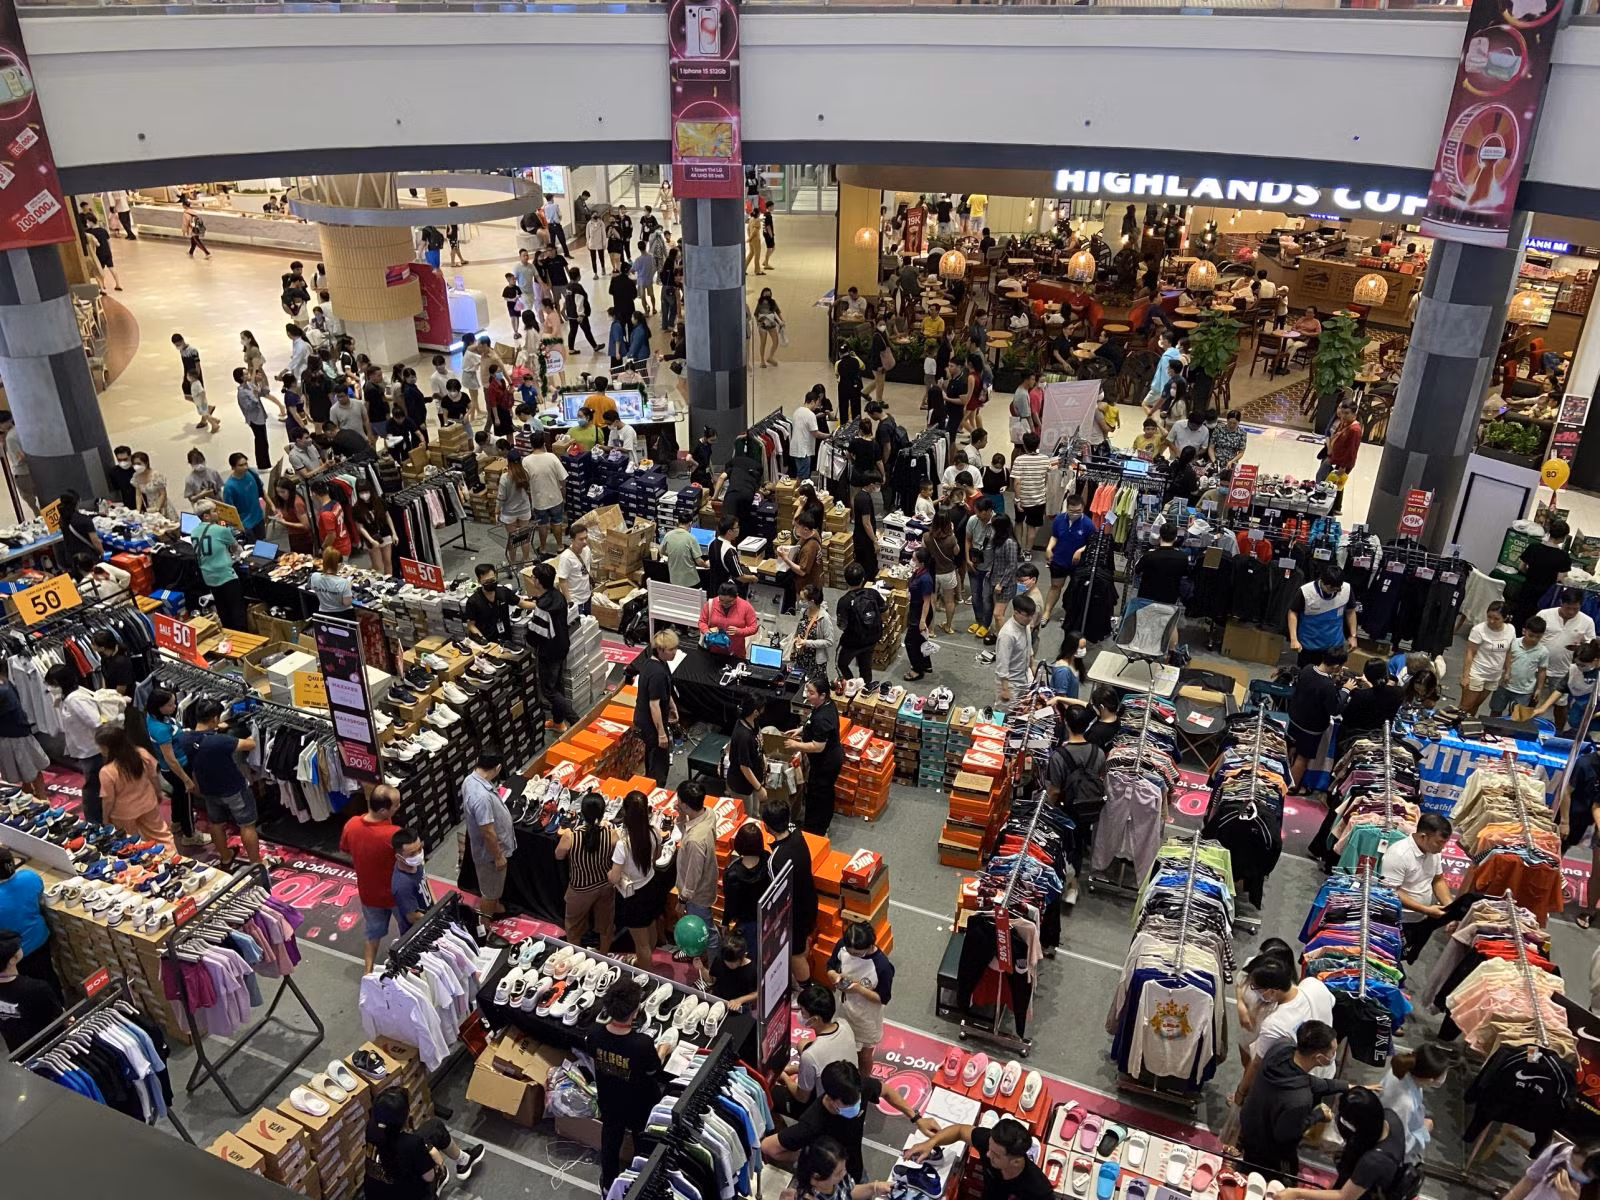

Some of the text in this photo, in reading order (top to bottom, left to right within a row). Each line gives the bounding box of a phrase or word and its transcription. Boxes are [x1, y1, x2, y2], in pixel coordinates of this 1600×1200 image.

[1055, 168, 1319, 206] HIGHLANDS
[1232, 489, 1248, 497] 69K
[1404, 516, 1421, 525] 69K
[881, 546, 894, 554] FILA
[160, 623, 171, 636] SALE
[173, 622, 190, 648] 50
[848, 728, 868, 745] NIKE
[292, 860, 307, 869] 10
[852, 853, 875, 871] NIKE
[886, 1051, 900, 1063] 10
[268, 1121, 288, 1134] ANTA
[227, 1150, 245, 1162] ANTA
